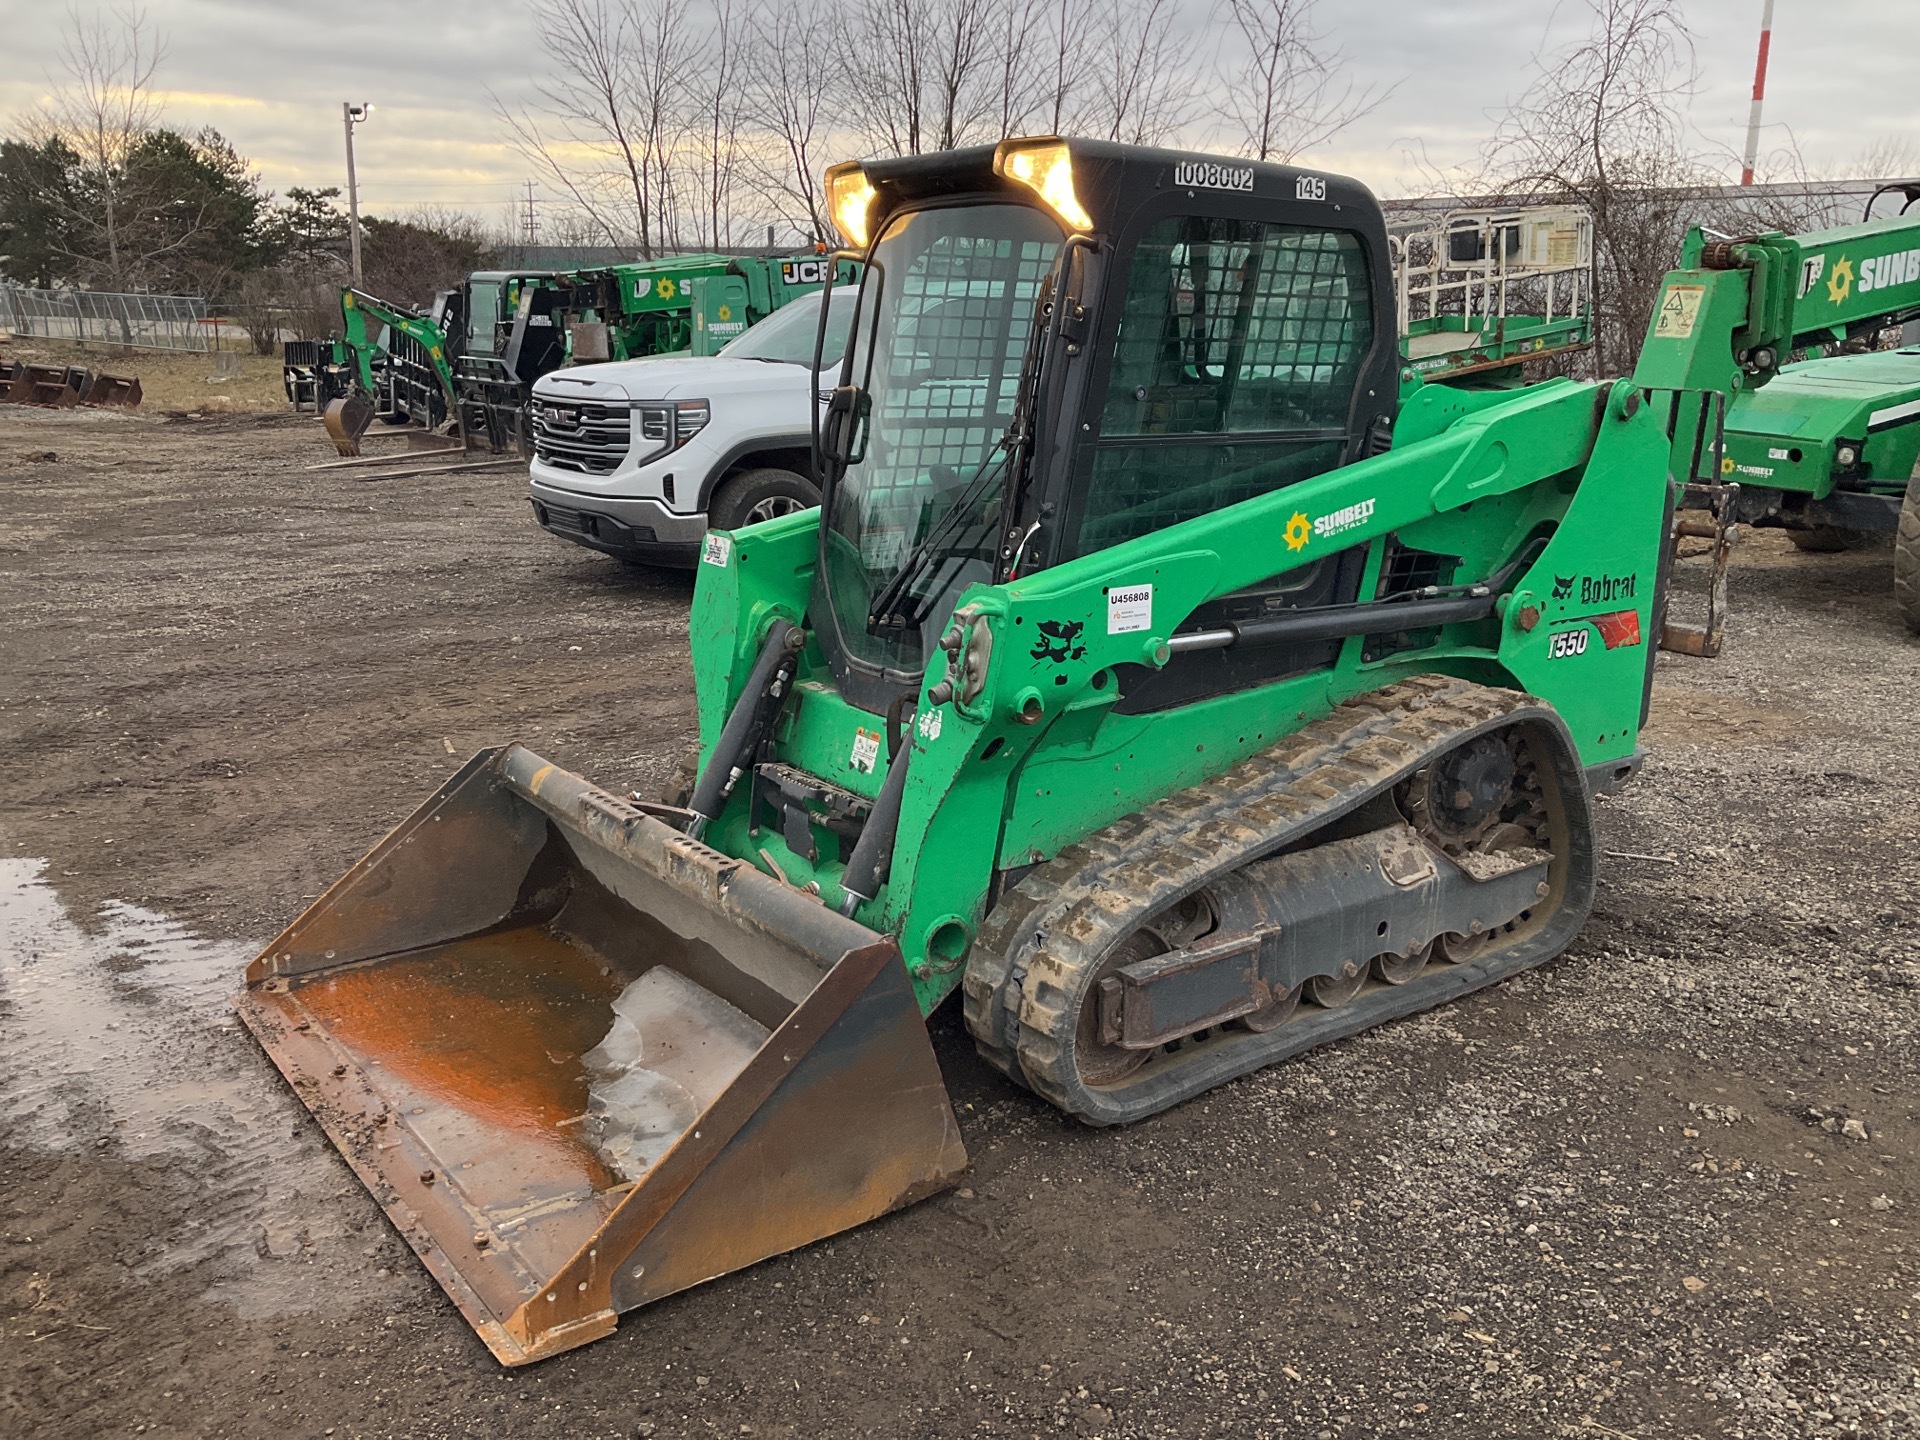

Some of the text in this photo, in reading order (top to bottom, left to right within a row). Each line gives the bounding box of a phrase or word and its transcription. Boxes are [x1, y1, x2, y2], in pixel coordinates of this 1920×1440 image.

[1176, 163, 1253, 190] 1008002
[1297, 176, 1325, 199] 145
[783, 262, 838, 284] JCB
[708, 322, 744, 332] SUNBELT
[544, 407, 577, 426] GMC
[1736, 464, 1775, 476] SUNBELT
[1313, 498, 1376, 535] SUNBELT
[1323, 516, 1369, 538] RENTALS
[1110, 591, 1150, 605] U456808
[1581, 572, 1637, 604] Bobcat
[1546, 628, 1589, 660] T550
